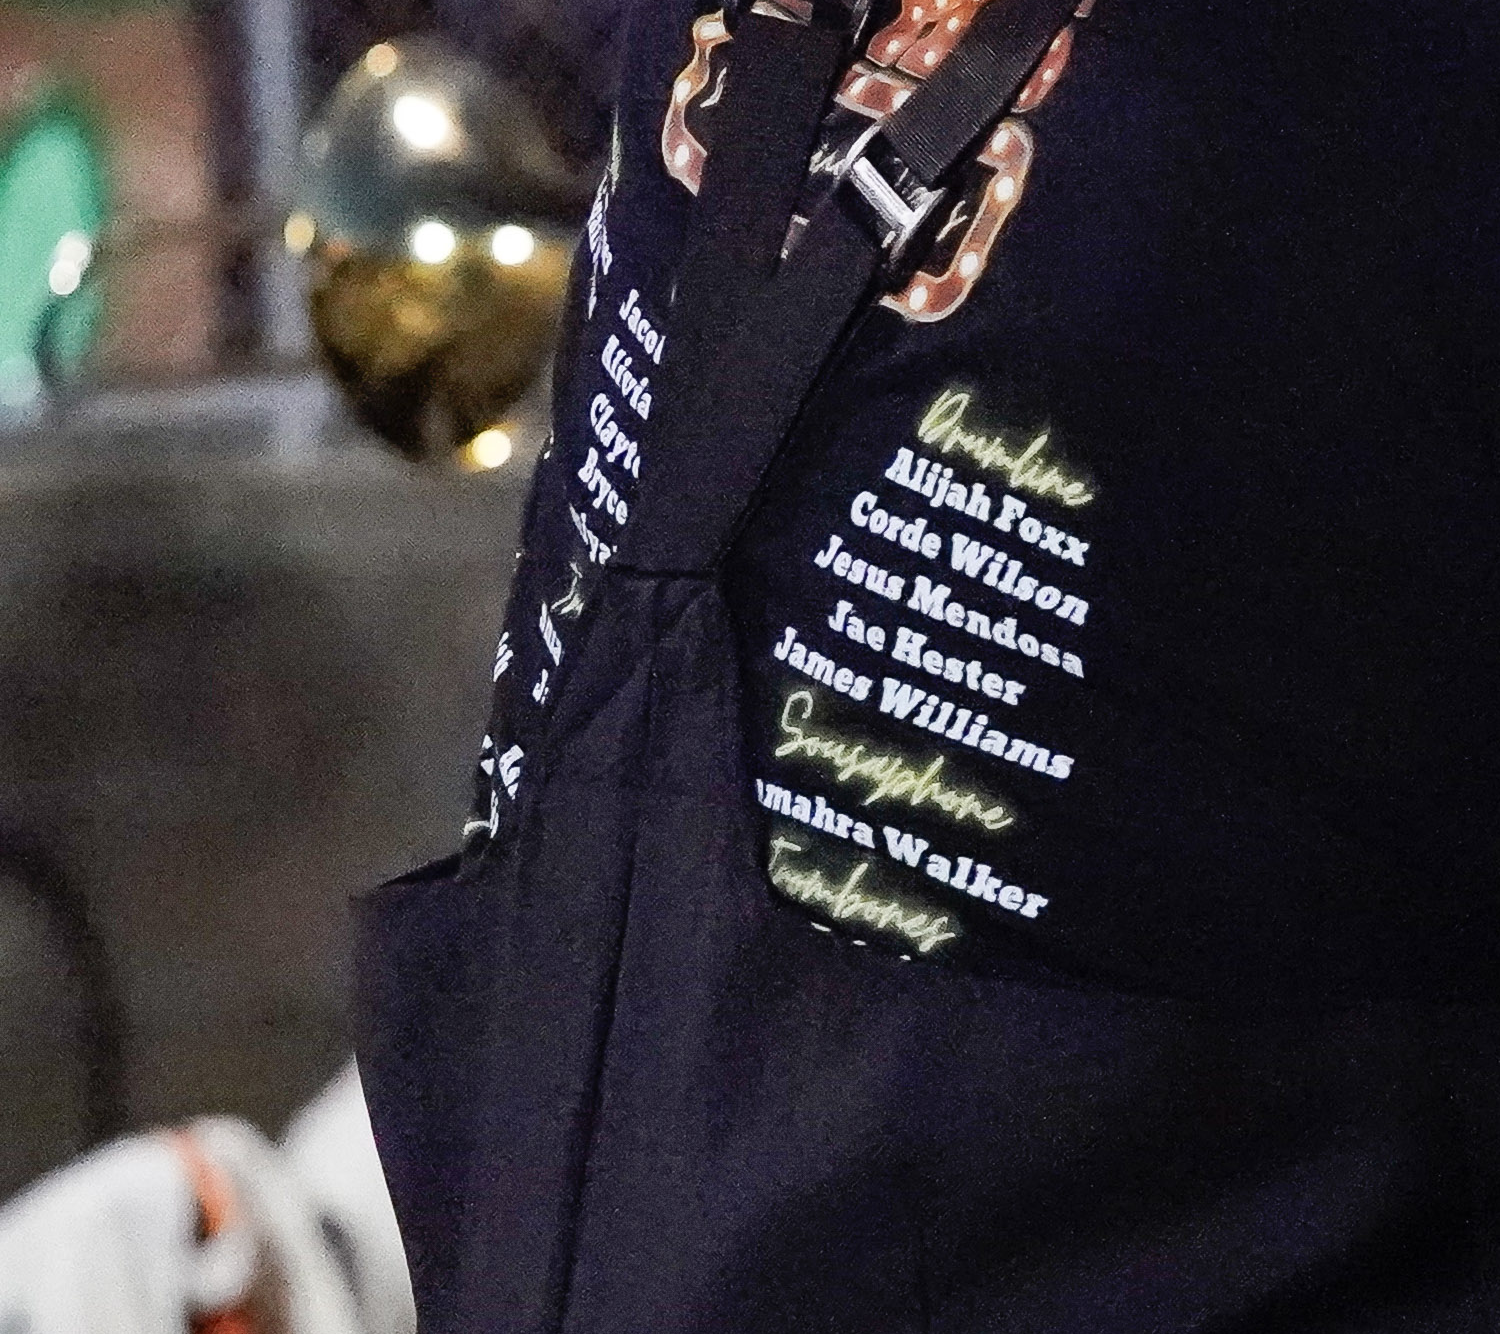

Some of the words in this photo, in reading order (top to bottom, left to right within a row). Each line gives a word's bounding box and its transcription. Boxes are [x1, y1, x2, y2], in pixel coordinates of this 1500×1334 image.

[577, 447, 628, 525] Bryce
[885, 447, 992, 522] Alijah
[994, 495, 1090, 567] Foxx
[918, 389, 1095, 507] Drumline
[814, 534, 905, 601] Jesus
[907, 575, 1085, 678] Mendosa
[850, 491, 942, 560] Corde
[951, 533, 1090, 627] Wilson
[773, 626, 874, 701] James
[879, 677, 1075, 780] Williams
[827, 600, 886, 651] Jae
[892, 627, 1026, 705] Hester
[775, 690, 1014, 830] Sousaphone
[882, 826, 1050, 918] Walker
